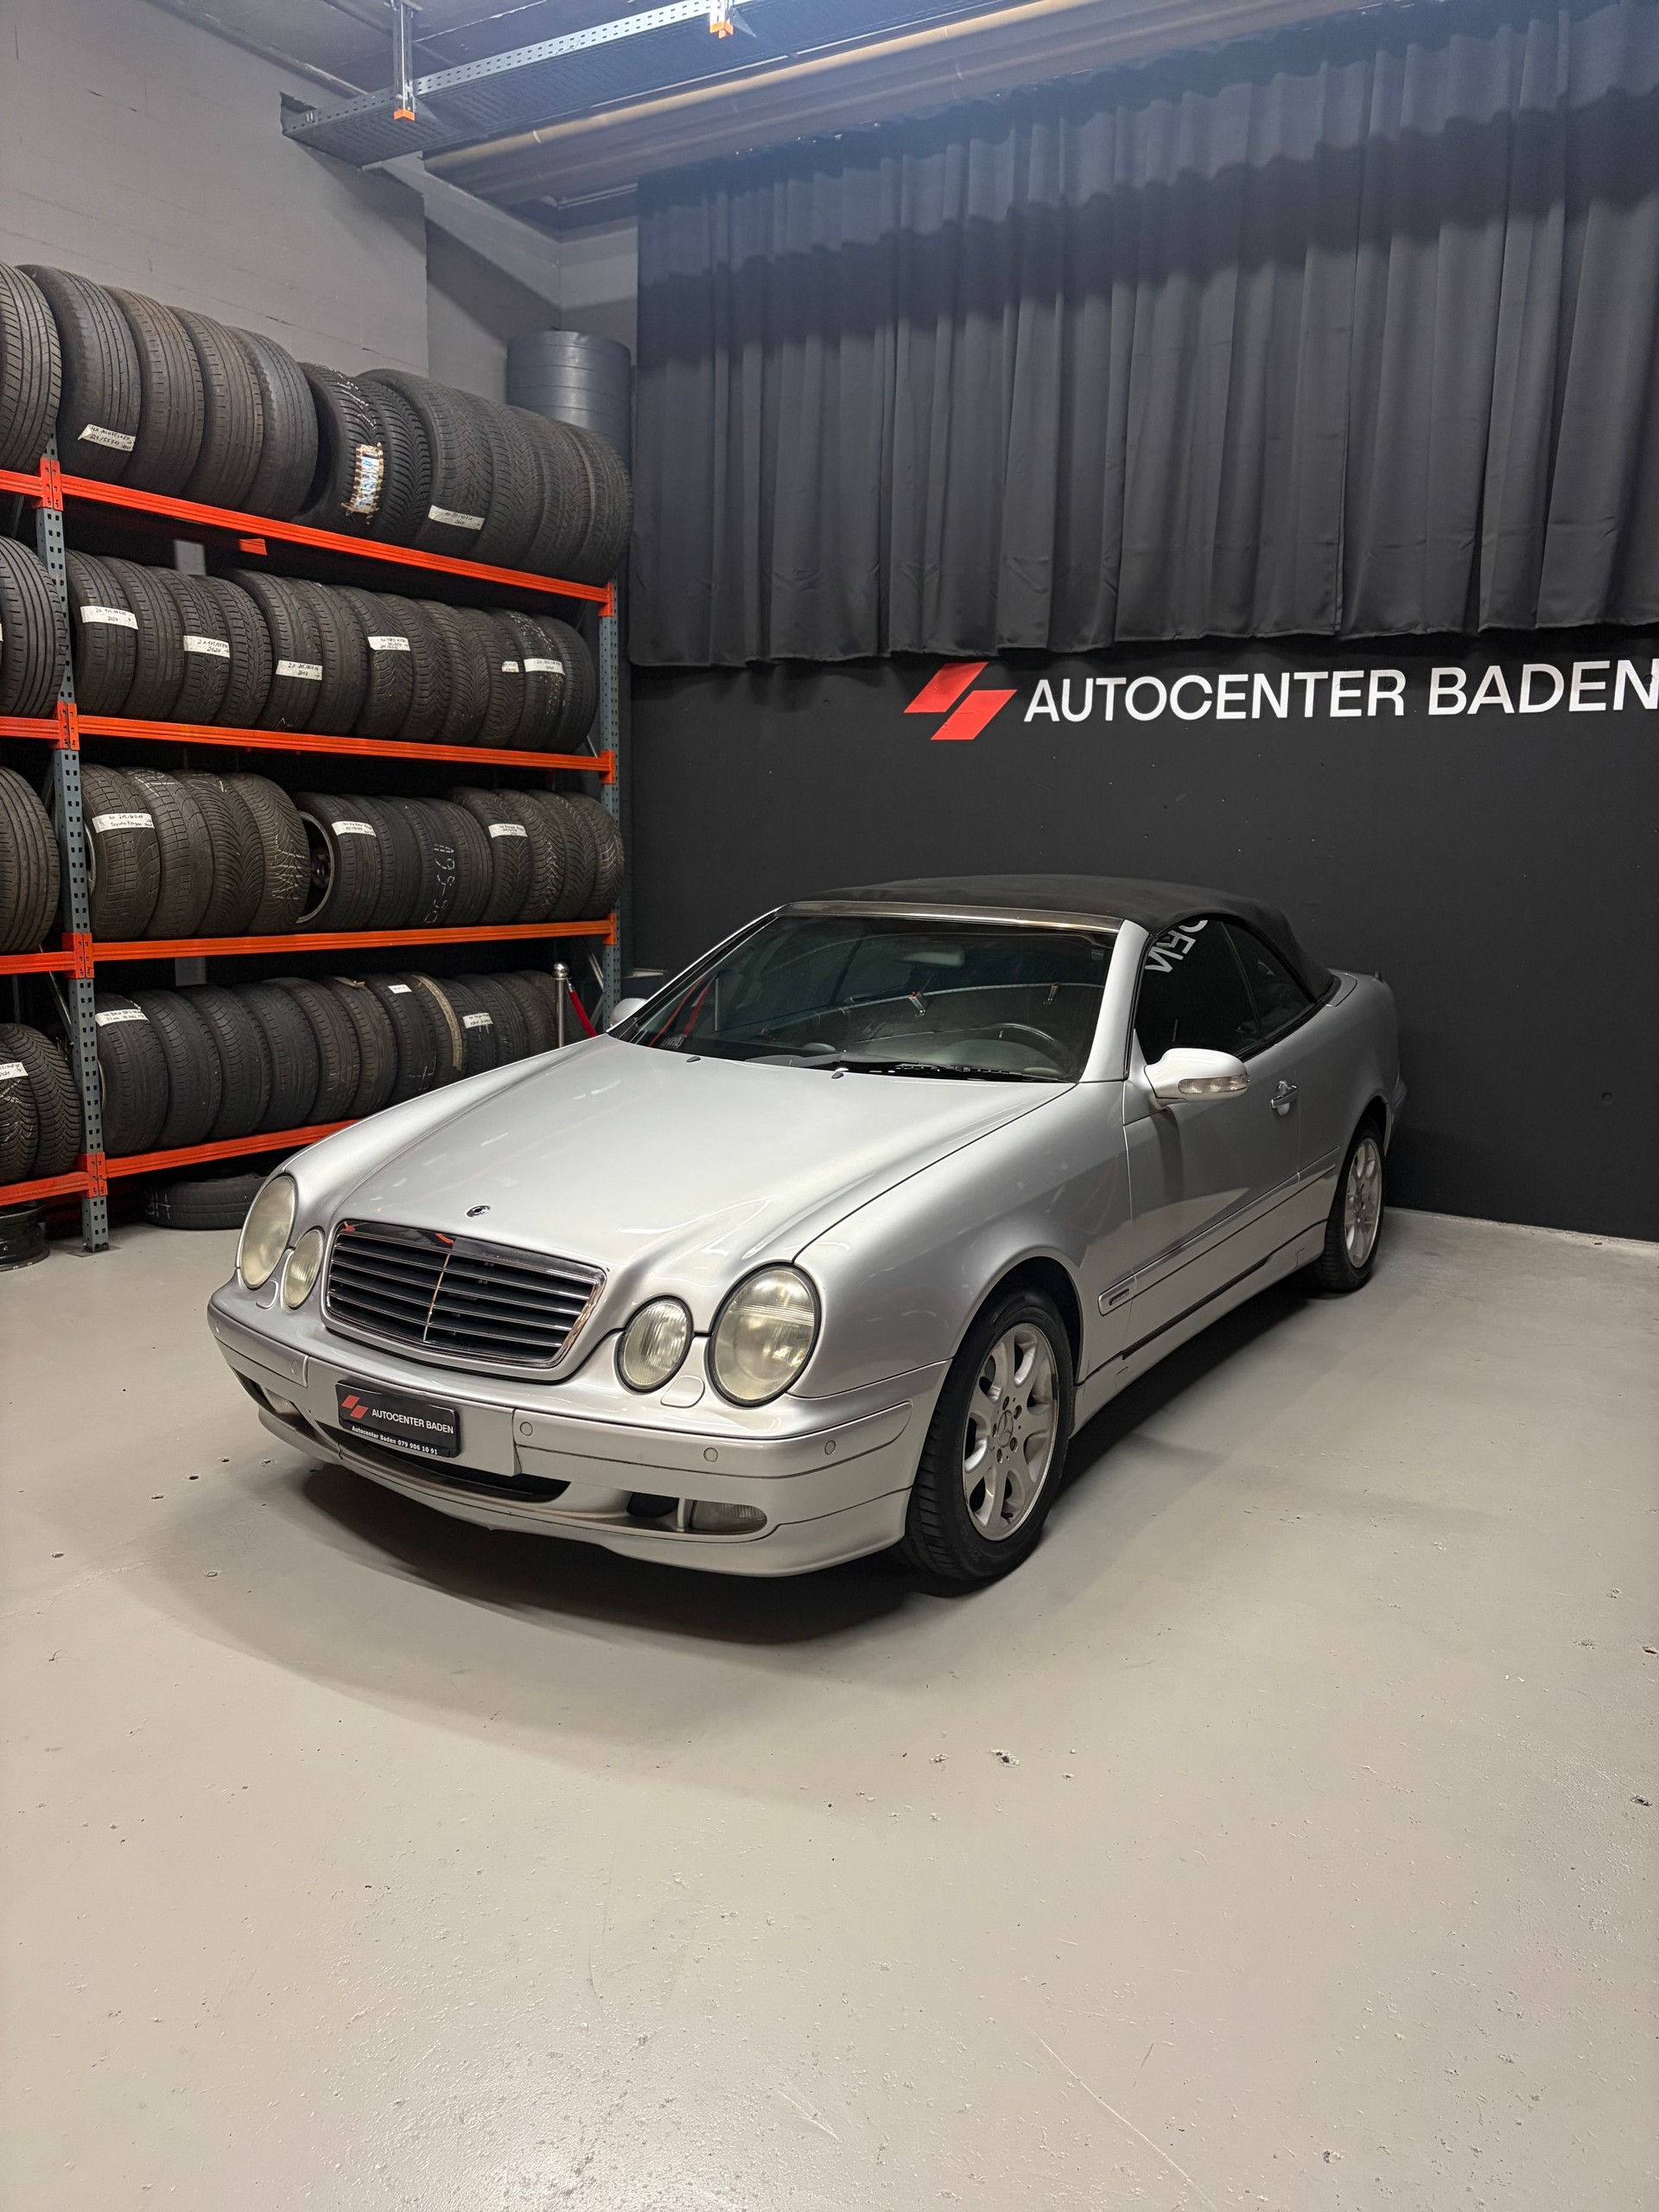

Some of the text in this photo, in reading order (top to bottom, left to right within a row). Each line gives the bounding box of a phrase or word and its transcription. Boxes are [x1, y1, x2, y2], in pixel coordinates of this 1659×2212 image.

[1024, 658, 1659, 722] AUTOCENTER BADEN
[372, 1408, 454, 1434] AUTOCENTER BADEN
[352, 1426, 379, 1440] Autocenter
[380, 1434, 397, 1445] Baden
[397, 1439, 408, 1447] 079
